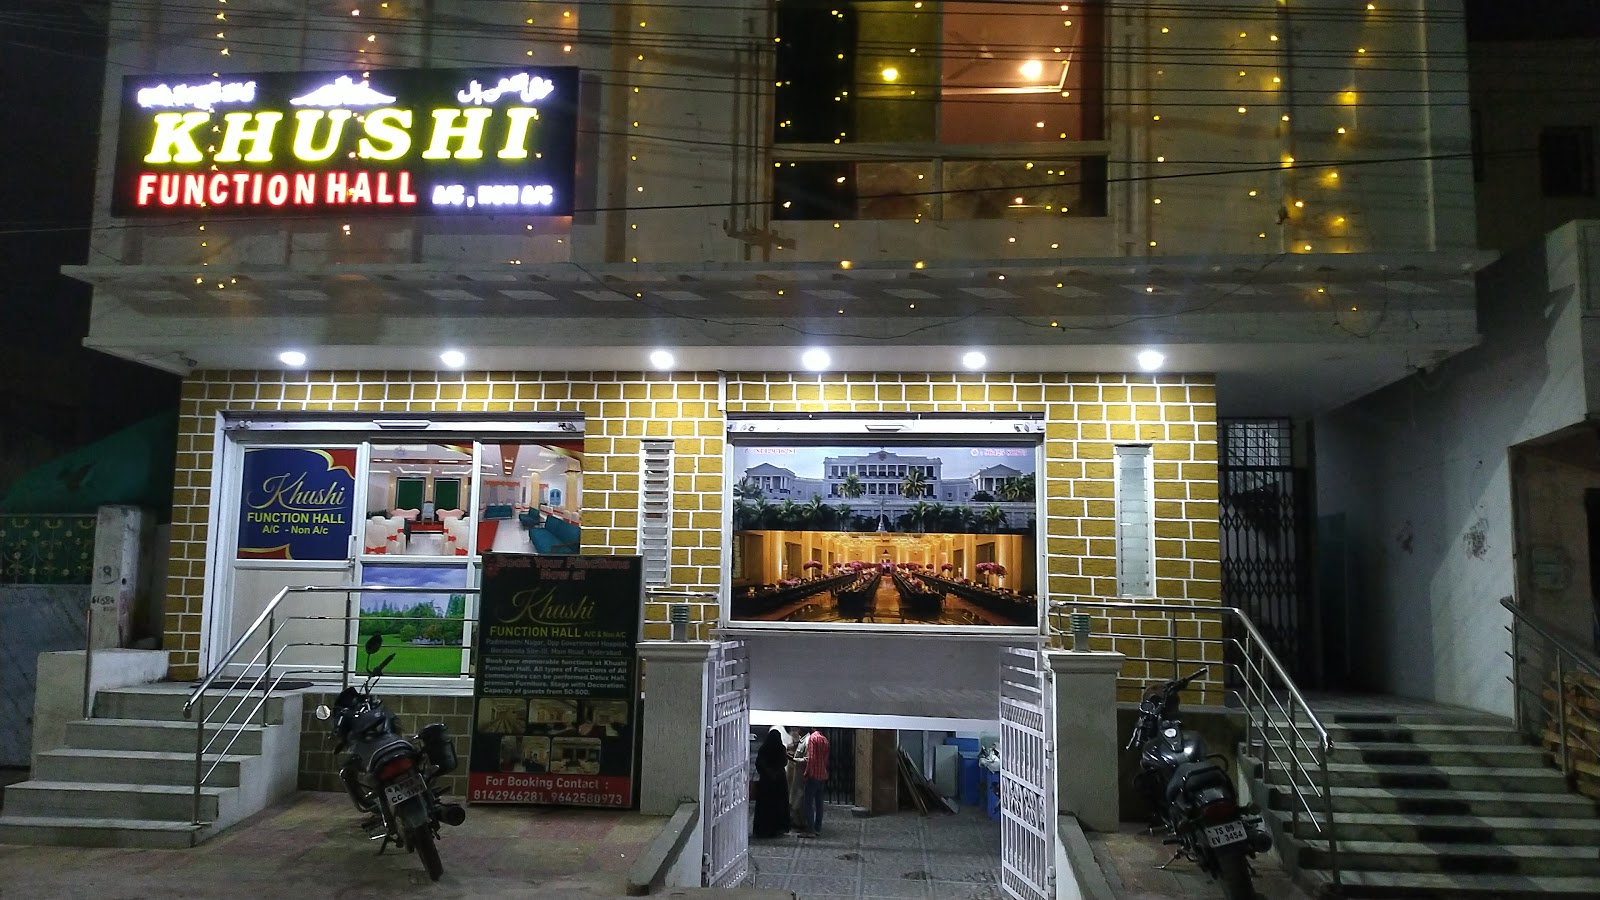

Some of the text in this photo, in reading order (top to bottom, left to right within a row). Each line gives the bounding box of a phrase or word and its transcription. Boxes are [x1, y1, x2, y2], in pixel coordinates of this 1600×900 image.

[143, 107, 539, 164] KHUSHI
[137, 171, 416, 206] FUNCTION HALL
[247, 471, 347, 511] Khushi
[247, 512, 346, 524] FUNCTION HALL
[262, 525, 280, 534] A/C
[290, 525, 311, 534] Non
[497, 585, 596, 625] Khushi
[490, 626, 549, 637] FUNCTION
[551, 627, 582, 638] HALL
[485, 776, 505, 786] For
[507, 776, 553, 790] Booking
[556, 778, 599, 789] Contact
[1214, 827, 1224, 835] TS
[1224, 830, 1243, 841] 3454
